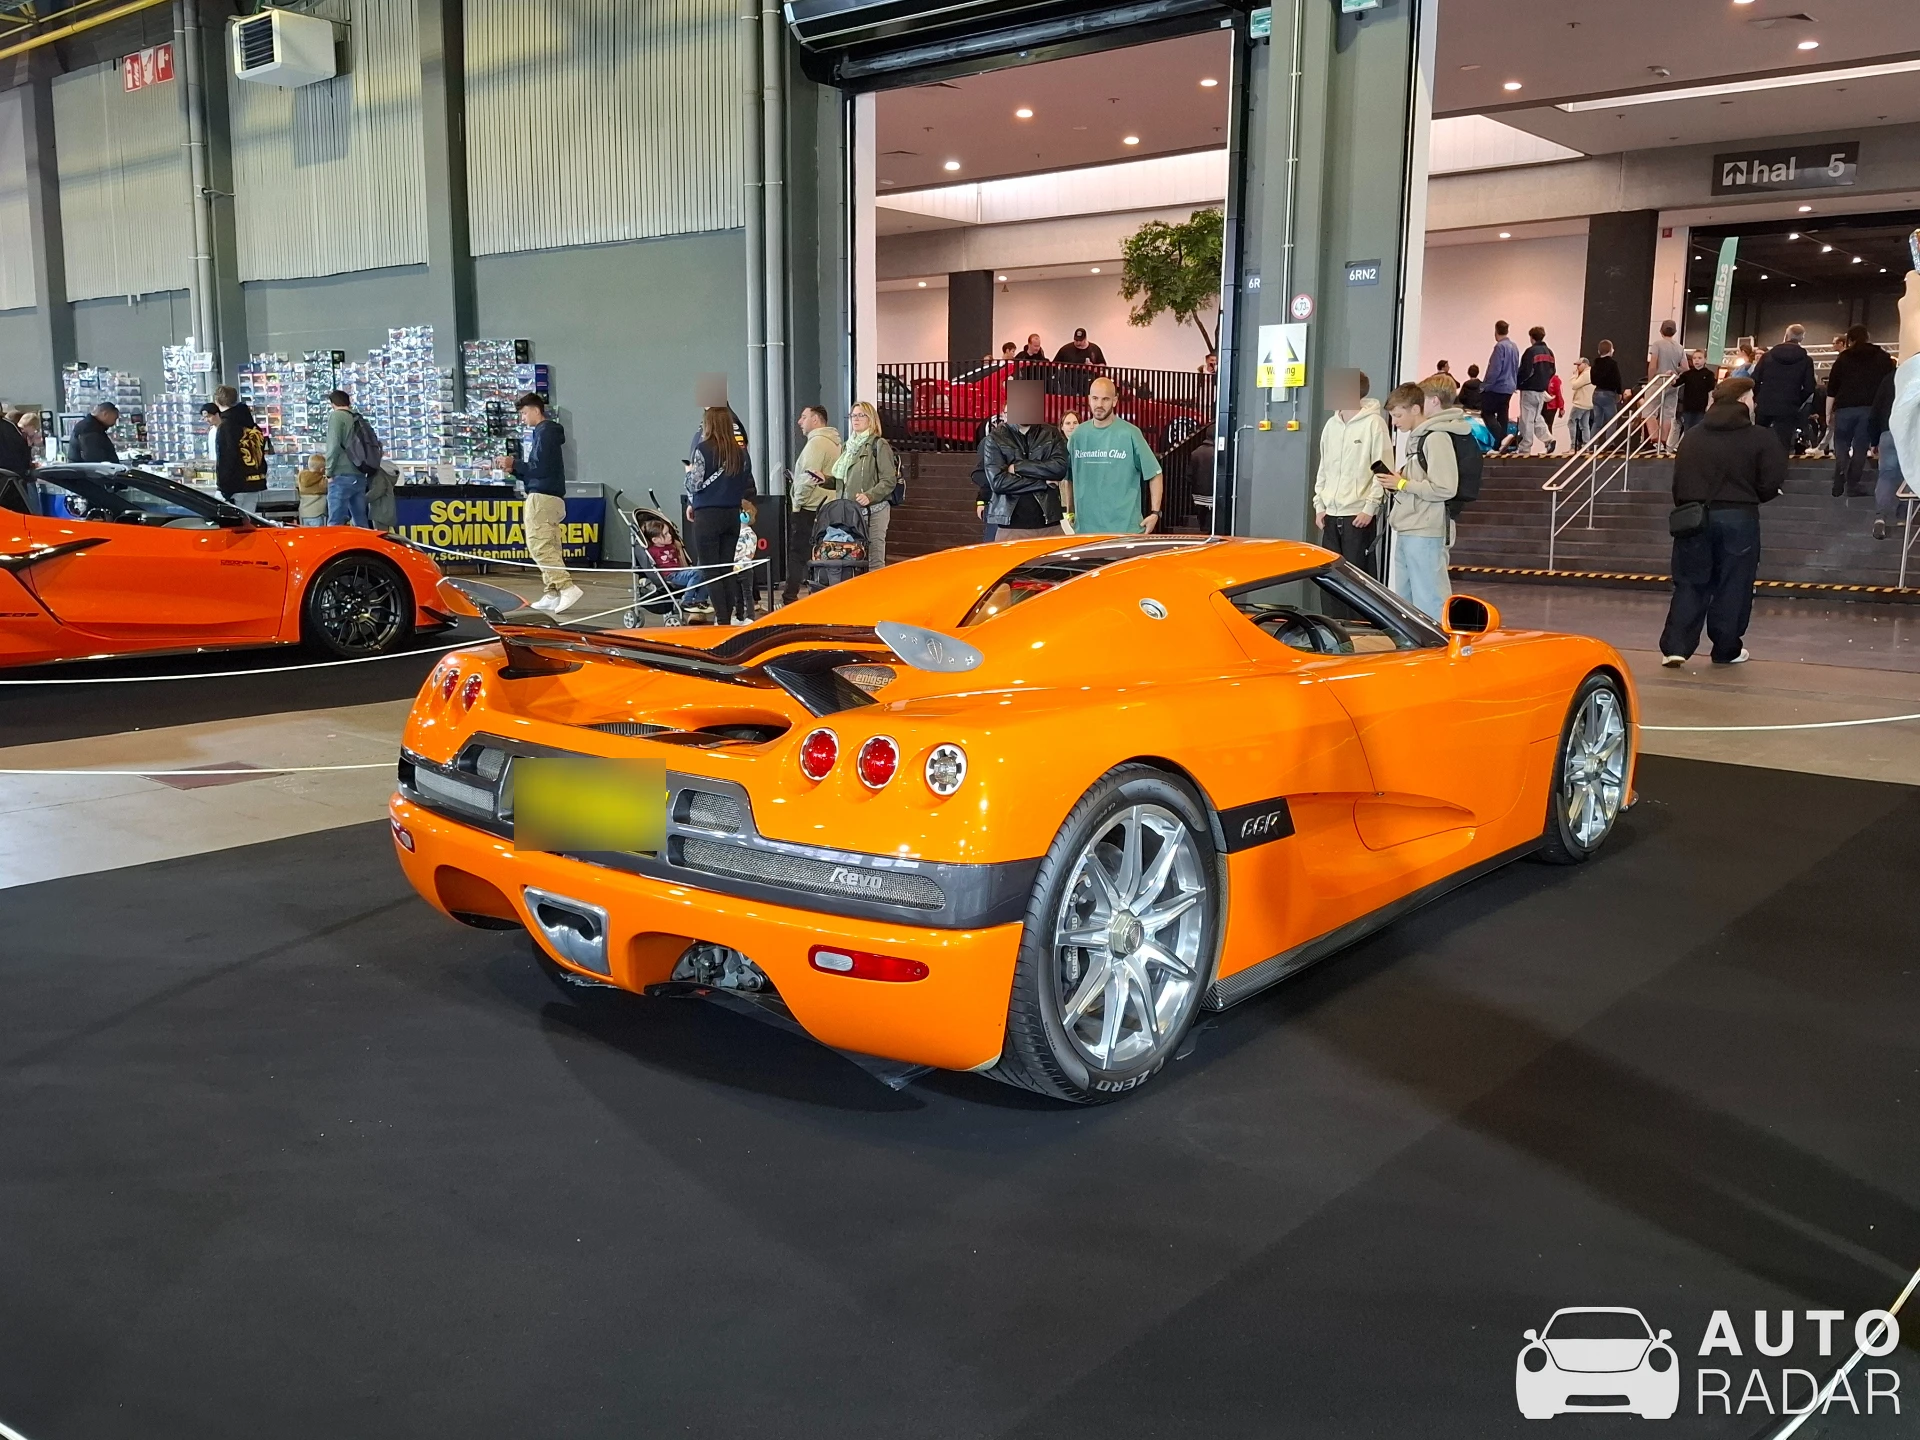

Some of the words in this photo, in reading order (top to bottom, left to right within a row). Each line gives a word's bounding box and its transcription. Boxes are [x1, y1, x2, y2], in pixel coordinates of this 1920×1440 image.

[1752, 156, 1796, 184] hal
[1827, 153, 1846, 178] 5
[1349, 268, 1376, 281] 6RN2
[1108, 449, 1127, 460] Club
[430, 500, 525, 523] SCHUIT
[829, 867, 882, 889] Revo
[1095, 1069, 1150, 1092] ZERO
